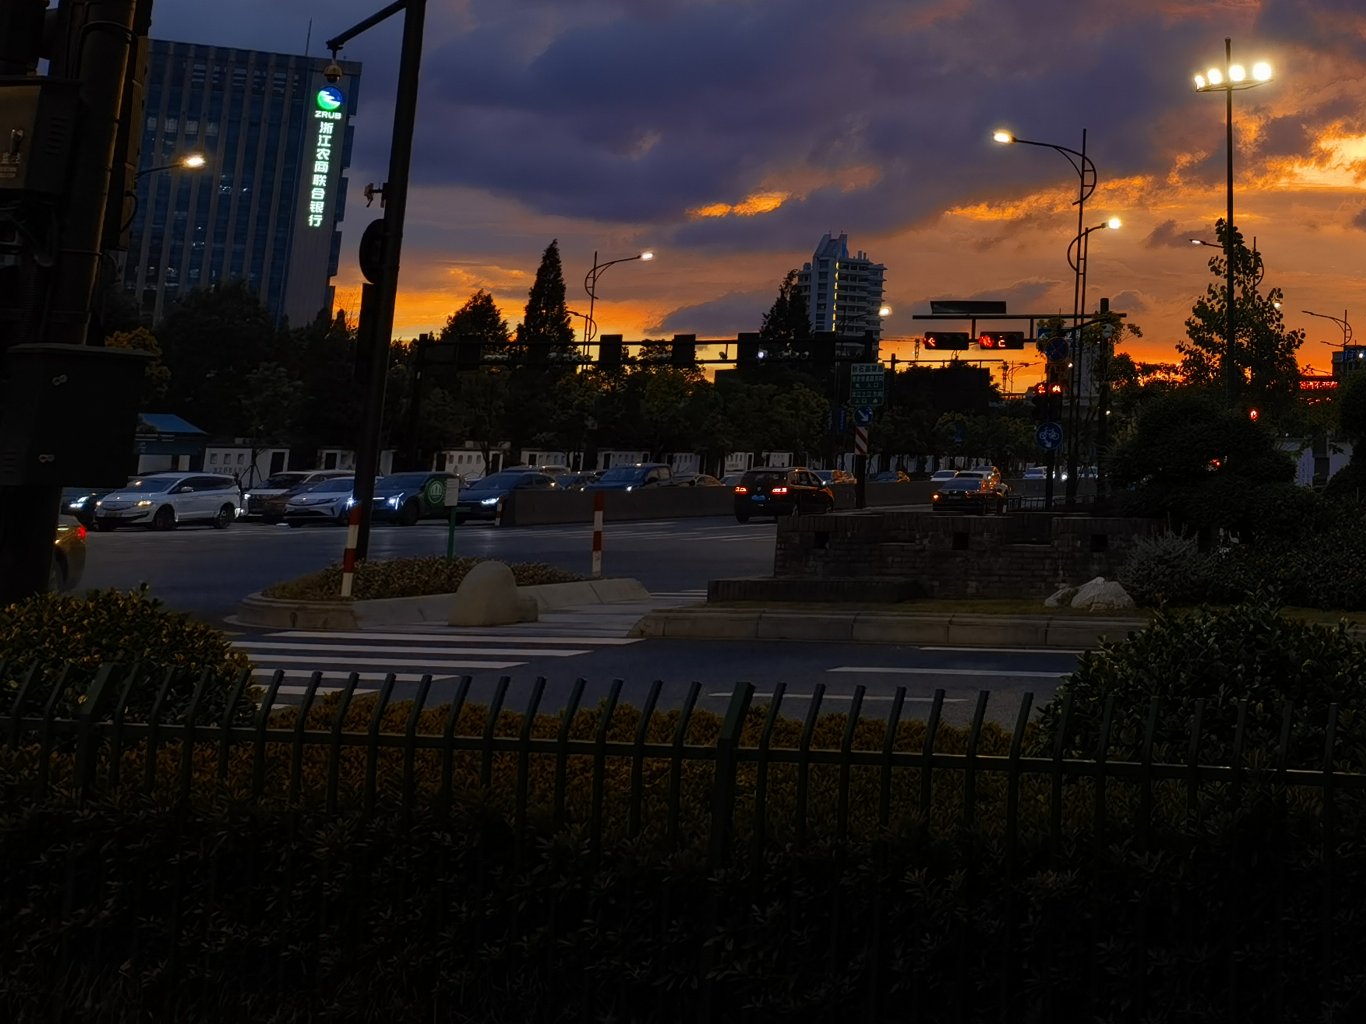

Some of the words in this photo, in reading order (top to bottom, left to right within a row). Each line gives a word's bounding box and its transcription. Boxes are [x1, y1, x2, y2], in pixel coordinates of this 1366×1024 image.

[314, 110, 342, 120] ZRUB
[308, 121, 335, 228] 浙江农商联合银行
